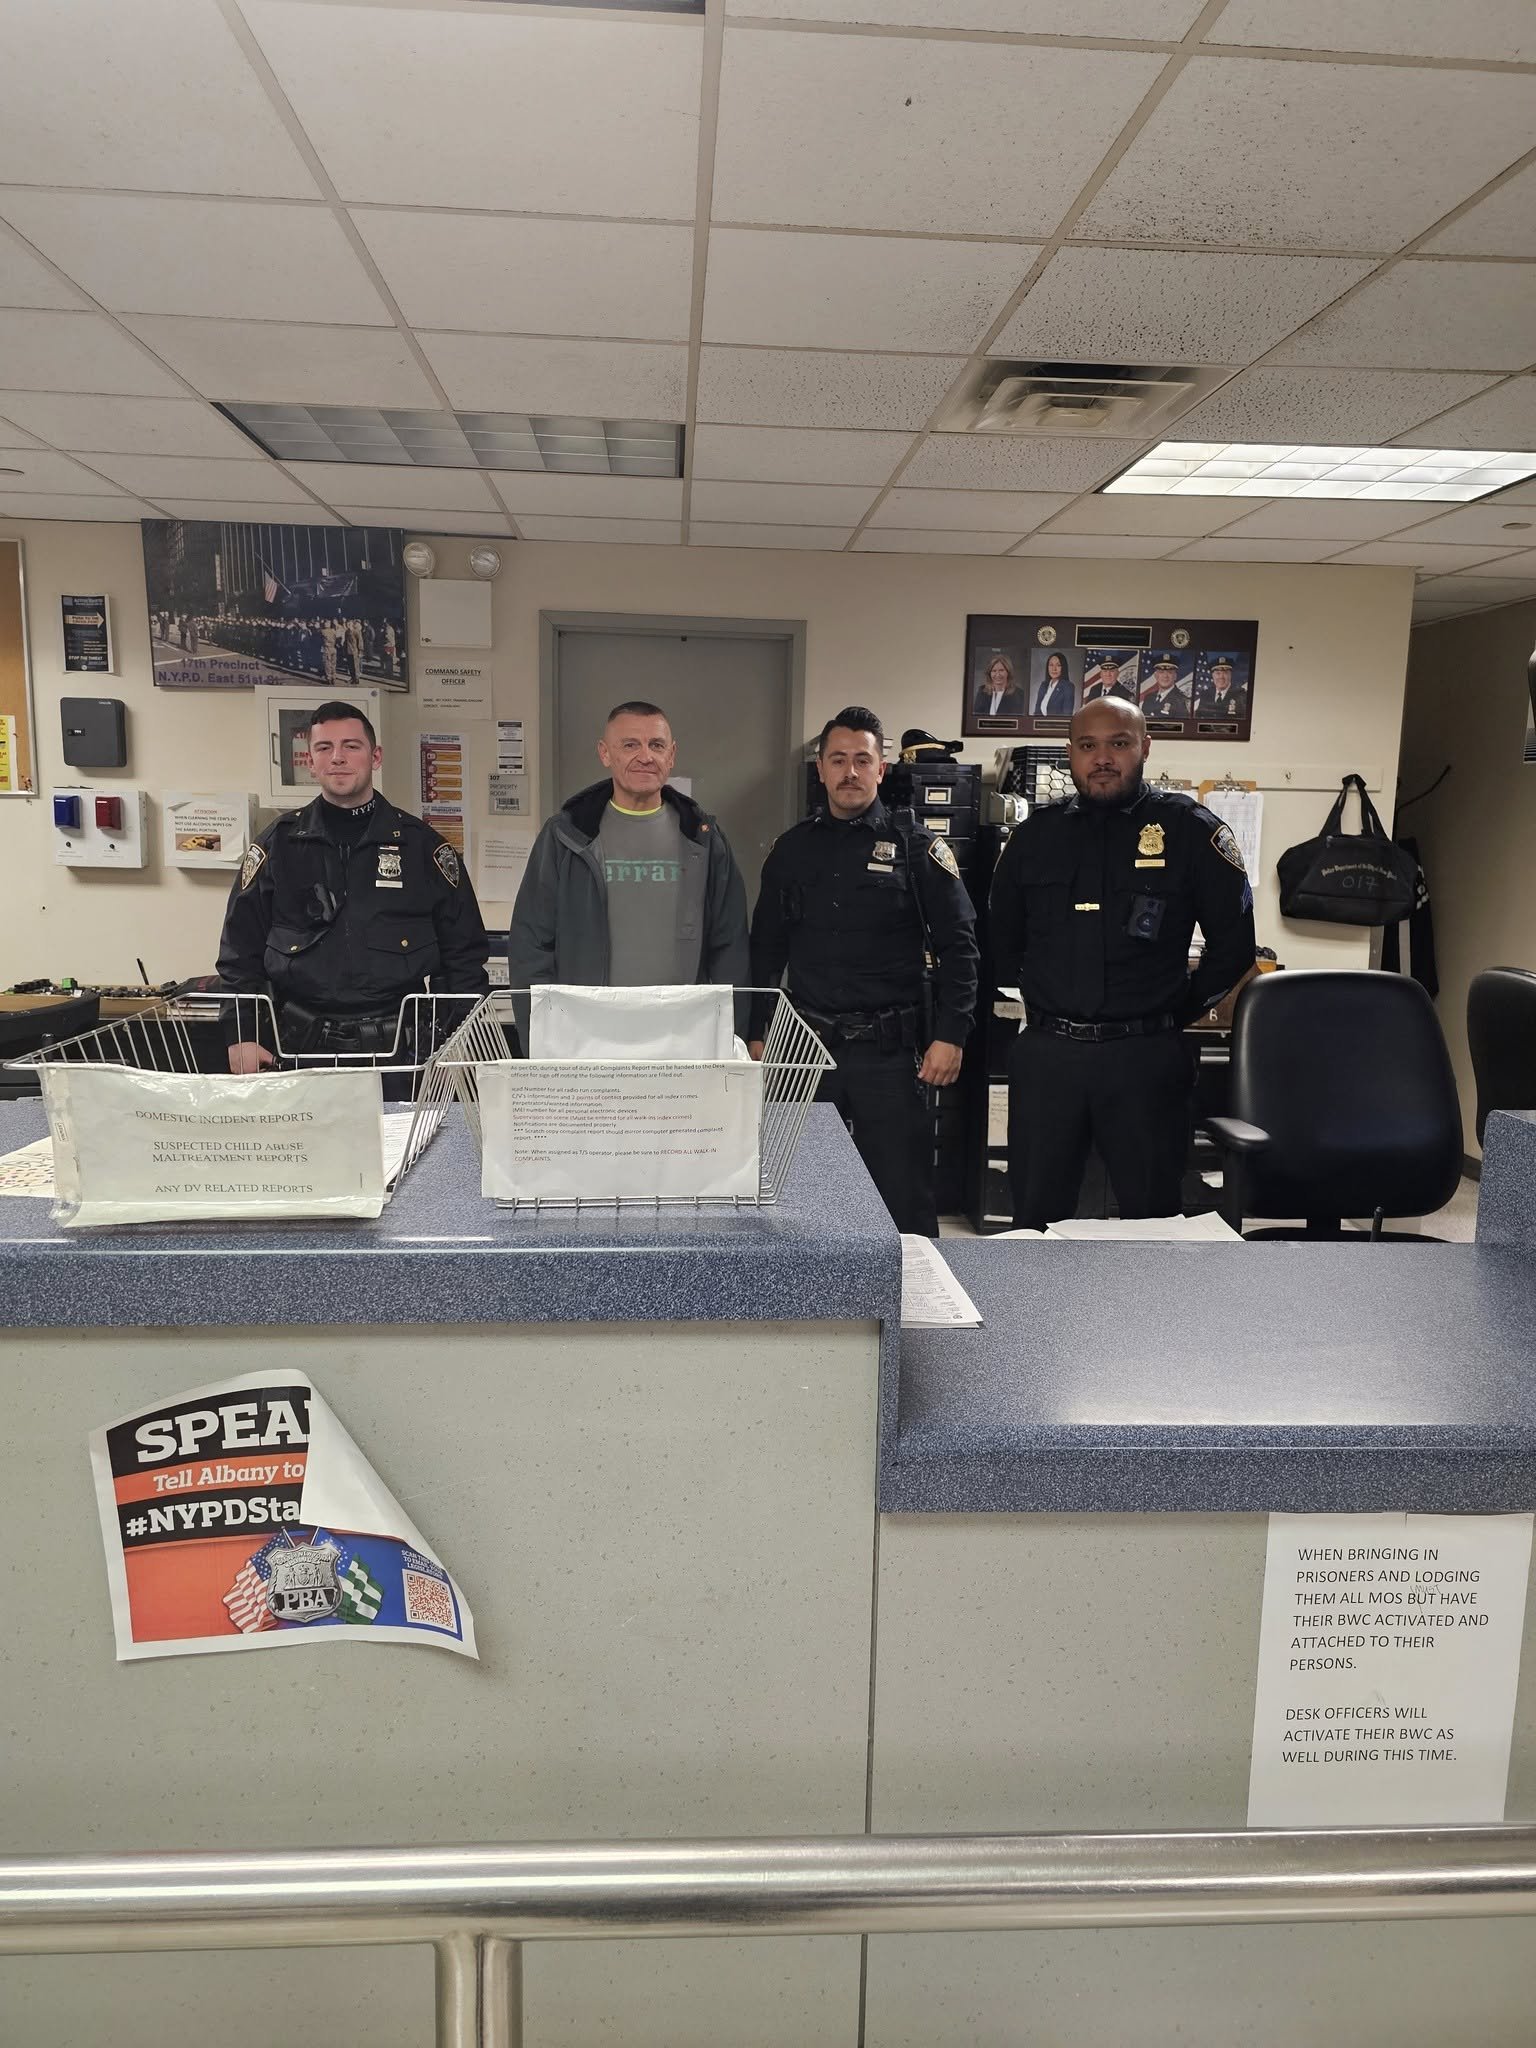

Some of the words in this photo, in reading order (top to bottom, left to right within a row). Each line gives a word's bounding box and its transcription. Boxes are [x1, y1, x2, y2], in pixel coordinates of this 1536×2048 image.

[182, 658, 206, 669] 17th
[210, 660, 260, 670] Precinct
[158, 671, 204, 682] N.Y.P.D.
[208, 673, 234, 683] East
[238, 674, 262, 684] 51st
[136, 1110, 196, 1123] DOMESTIC
[200, 1115, 256, 1124] INCIDENT
[260, 1112, 313, 1124] REPORTS
[154, 1142, 222, 1151] SUSPECTED
[225, 1142, 262, 1151] CHILD
[152, 1154, 252, 1162] MALTREATMENT
[256, 1154, 308, 1162] REPORTS
[134, 1400, 311, 1463] SPEA
[153, 1469, 192, 1492] Tell
[197, 1464, 279, 1485] Albany
[283, 1461, 304, 1478] to
[126, 1497, 300, 1537] #NYPDSta
[1298, 1549, 1343, 1561] WHEN
[1348, 1549, 1419, 1561] BRINGING
[1423, 1549, 1439, 1561] IN
[1296, 1570, 1374, 1583] PRISONERS
[1378, 1571, 1410, 1582] AND
[1415, 1570, 1480, 1583] LODGING
[282, 1589, 331, 1610] PBA
[1295, 1592, 1336, 1605] THEM
[1340, 1592, 1364, 1604] ALL
[1368, 1592, 1403, 1604] MOS
[1407, 1592, 1436, 1604] BUT
[1440, 1592, 1478, 1604] HAVE
[1294, 1615, 1333, 1627] THEIR
[1337, 1614, 1371, 1626] BWC
[1374, 1614, 1454, 1626] ACTIVATED
[1458, 1614, 1489, 1626] AND
[1291, 1635, 1365, 1649] ATTACHED
[1370, 1635, 1389, 1647] TO
[1394, 1636, 1434, 1648] THEIR
[1290, 1657, 1356, 1671] PERSONS.
[1286, 1708, 1320, 1721] DESK
[1324, 1707, 1390, 1720] OFFICERS
[1394, 1707, 1427, 1719] WILL
[1283, 1729, 1350, 1742] ACTIVATE
[1355, 1728, 1394, 1740] THEIR
[1399, 1728, 1432, 1740] BWC
[1436, 1728, 1454, 1740] AS
[1282, 1751, 1319, 1763] WELL
[1324, 1750, 1378, 1763] DURING
[1383, 1749, 1414, 1761] THIS
[1418, 1749, 1457, 1761] TIME.
